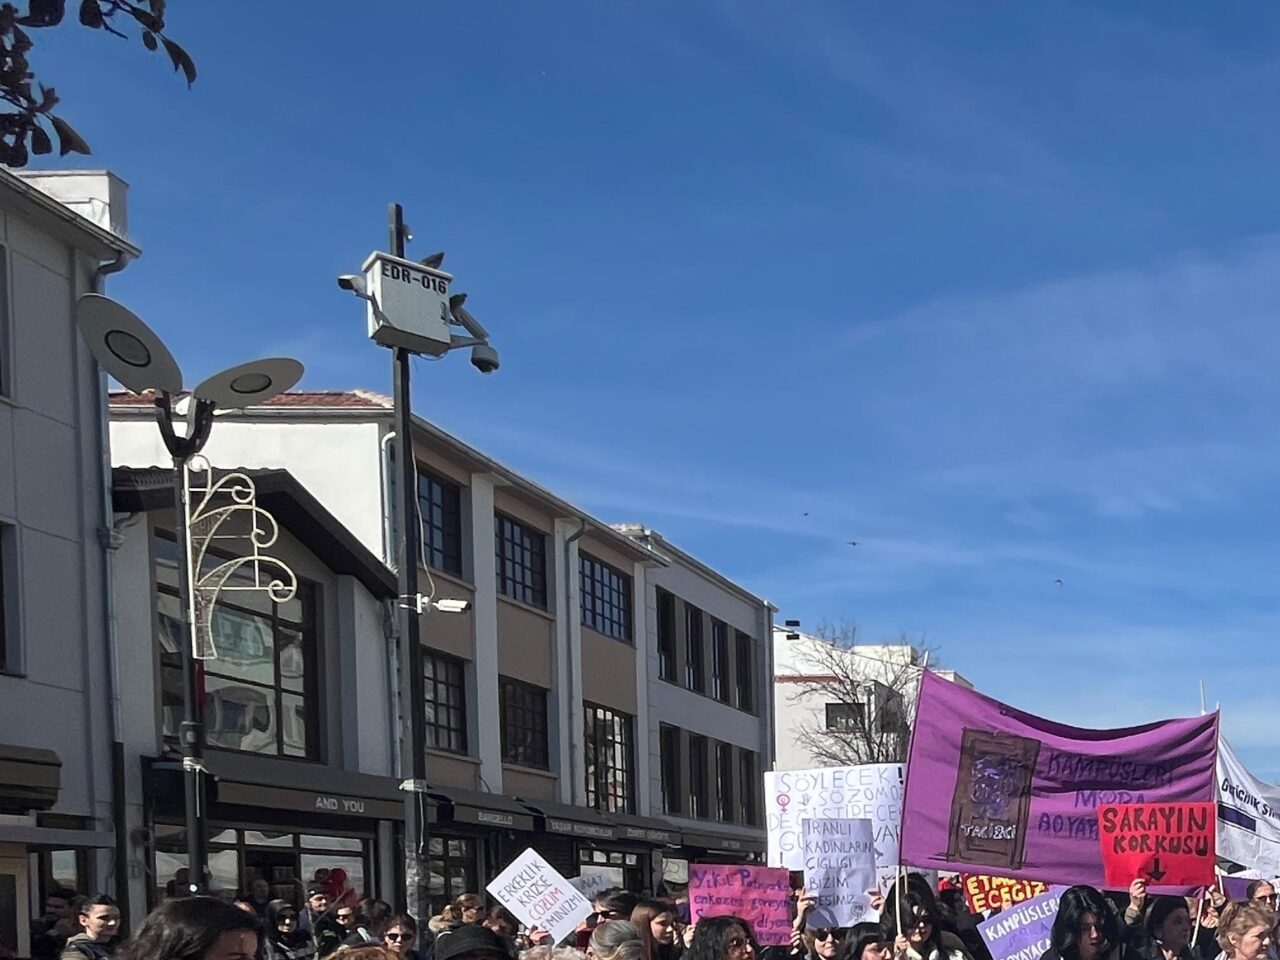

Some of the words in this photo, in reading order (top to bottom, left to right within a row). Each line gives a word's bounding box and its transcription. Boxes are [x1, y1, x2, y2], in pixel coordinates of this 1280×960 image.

[382, 262, 447, 294] EDR-016
[315, 797, 339, 811] AND
[343, 799, 365, 813] YOU
[1102, 807, 1208, 835] SARAYIN
[1112, 834, 1209, 857] KORKUSU
